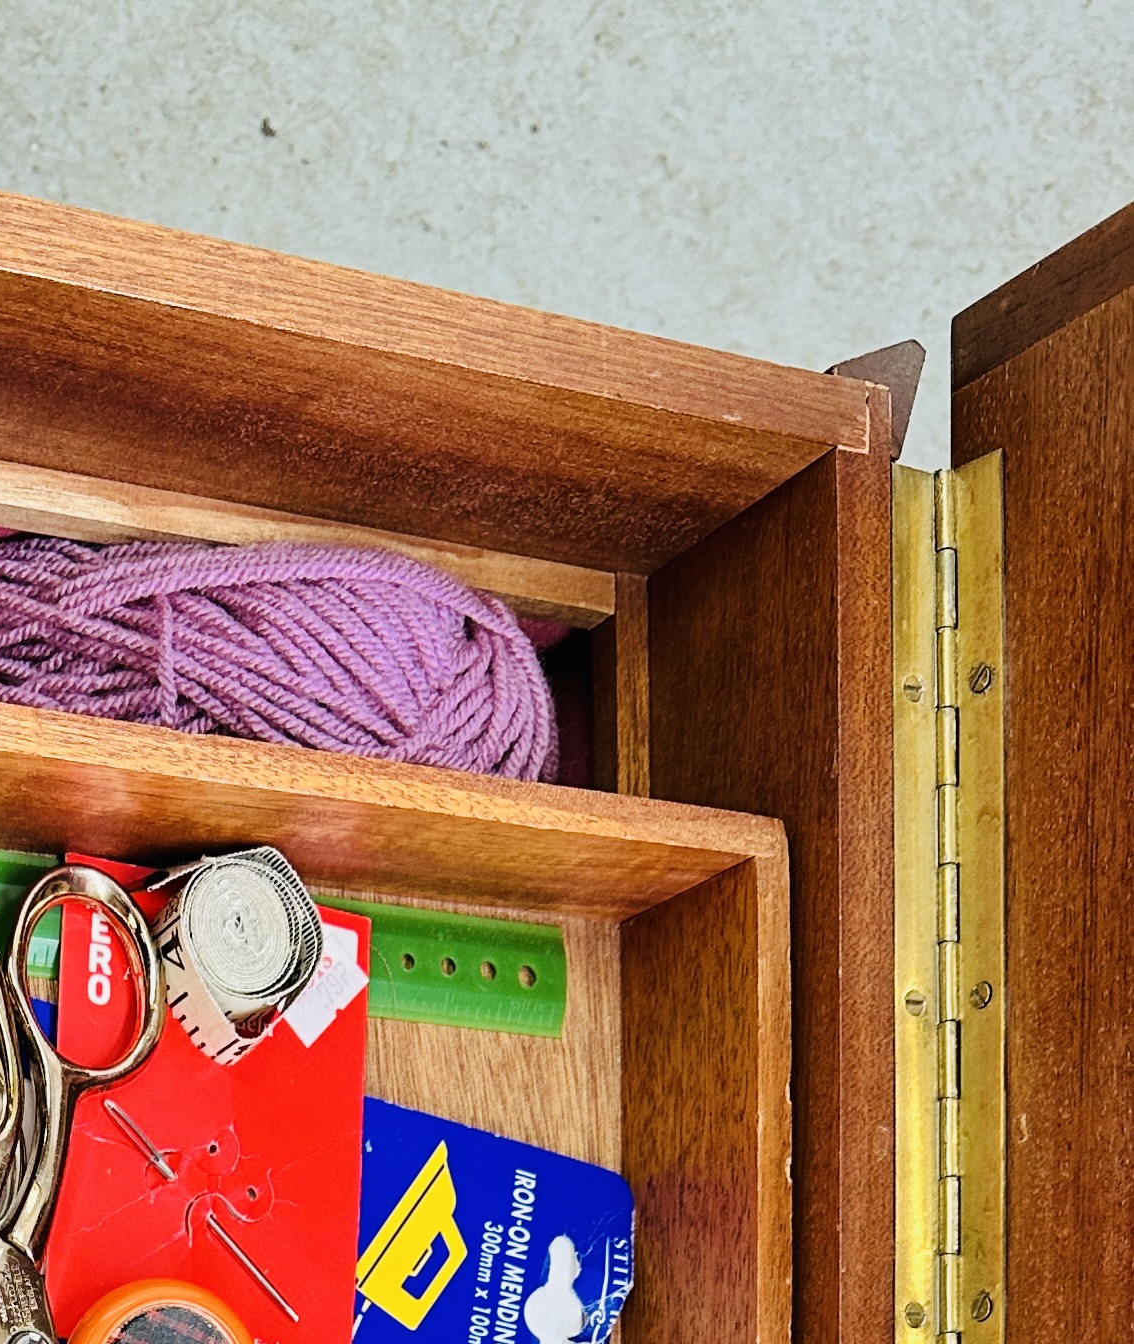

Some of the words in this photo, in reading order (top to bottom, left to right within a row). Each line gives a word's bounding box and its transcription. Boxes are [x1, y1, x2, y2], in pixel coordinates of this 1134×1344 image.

[87, 908, 112, 1006] ERO
[477, 1220, 504, 1283] 300mm
[505, 1168, 537, 1260] IRON-ON
